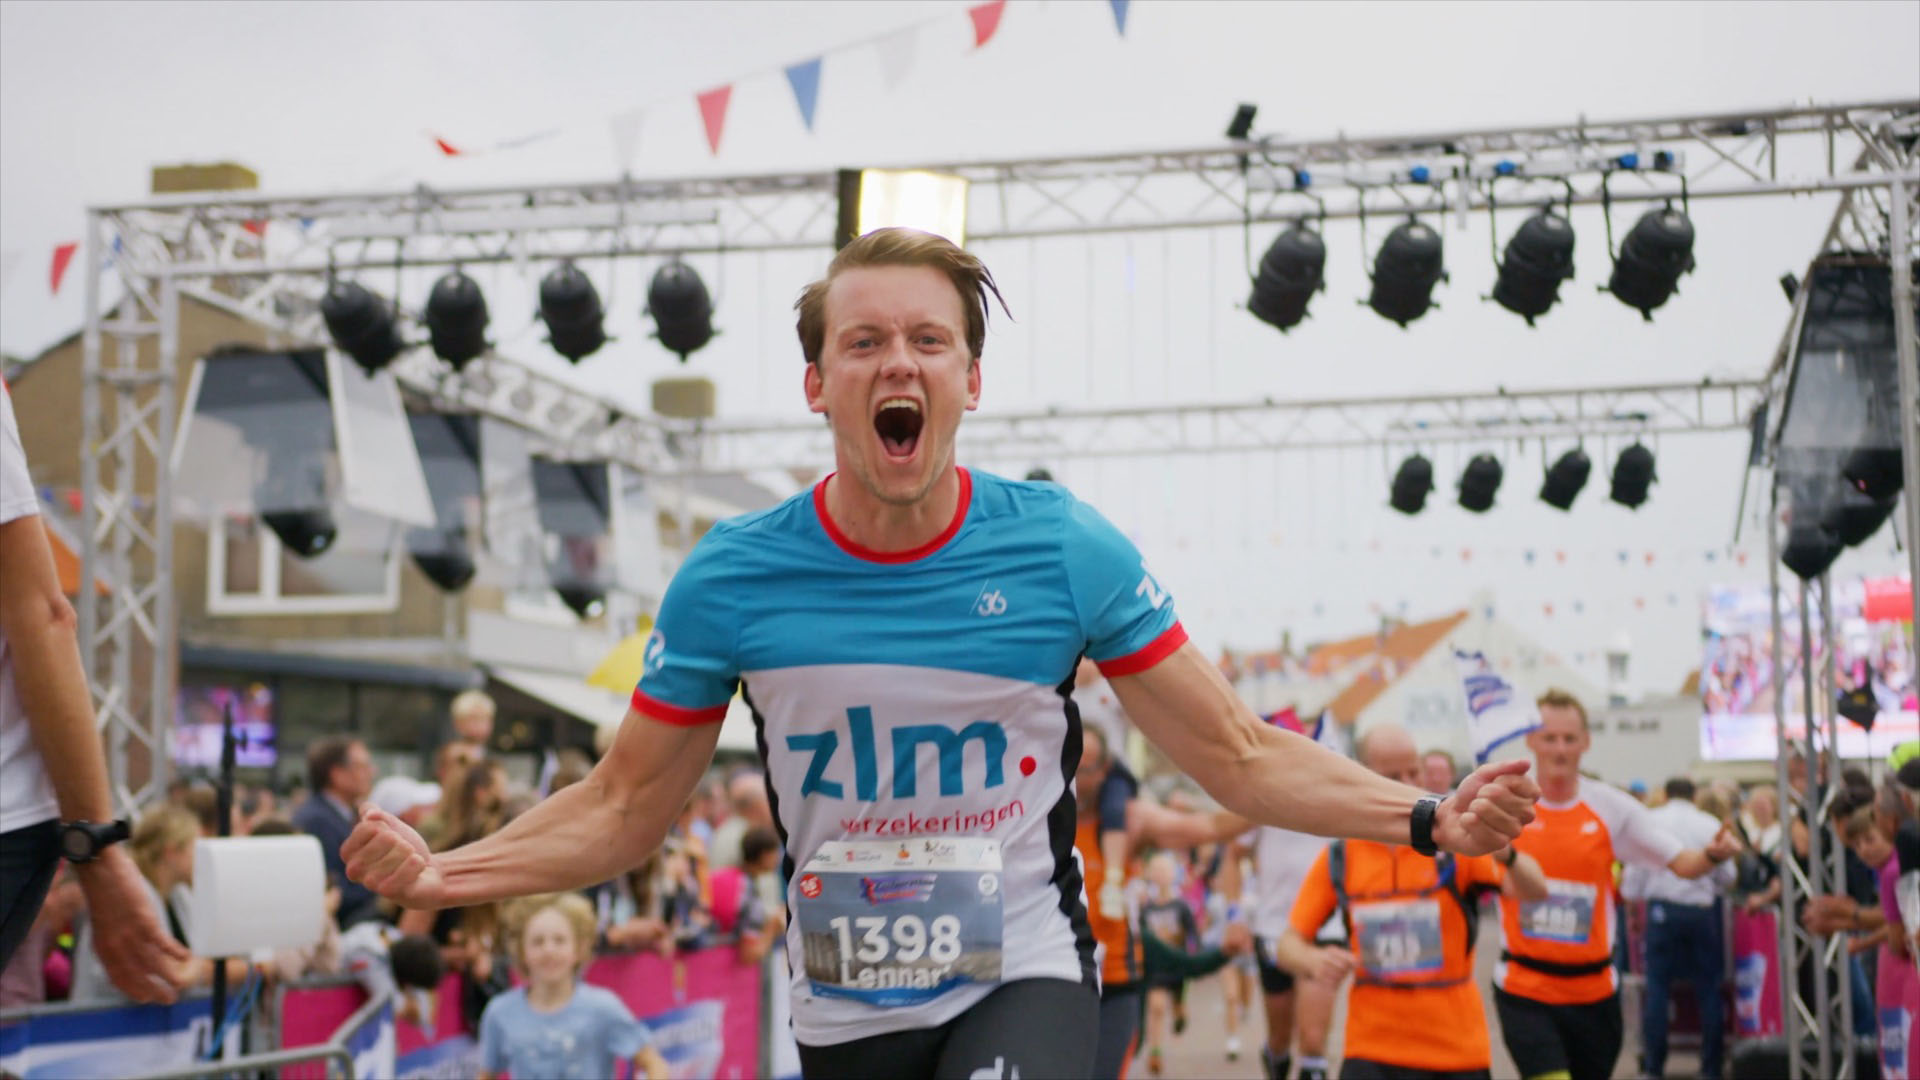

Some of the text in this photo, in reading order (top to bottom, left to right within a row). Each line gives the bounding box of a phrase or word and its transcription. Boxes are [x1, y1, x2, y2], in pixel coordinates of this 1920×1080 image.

[840, 800, 1025, 834] verzekeringen
[830, 914, 963, 964] 1398
[840, 962, 951, 990] Lennar
